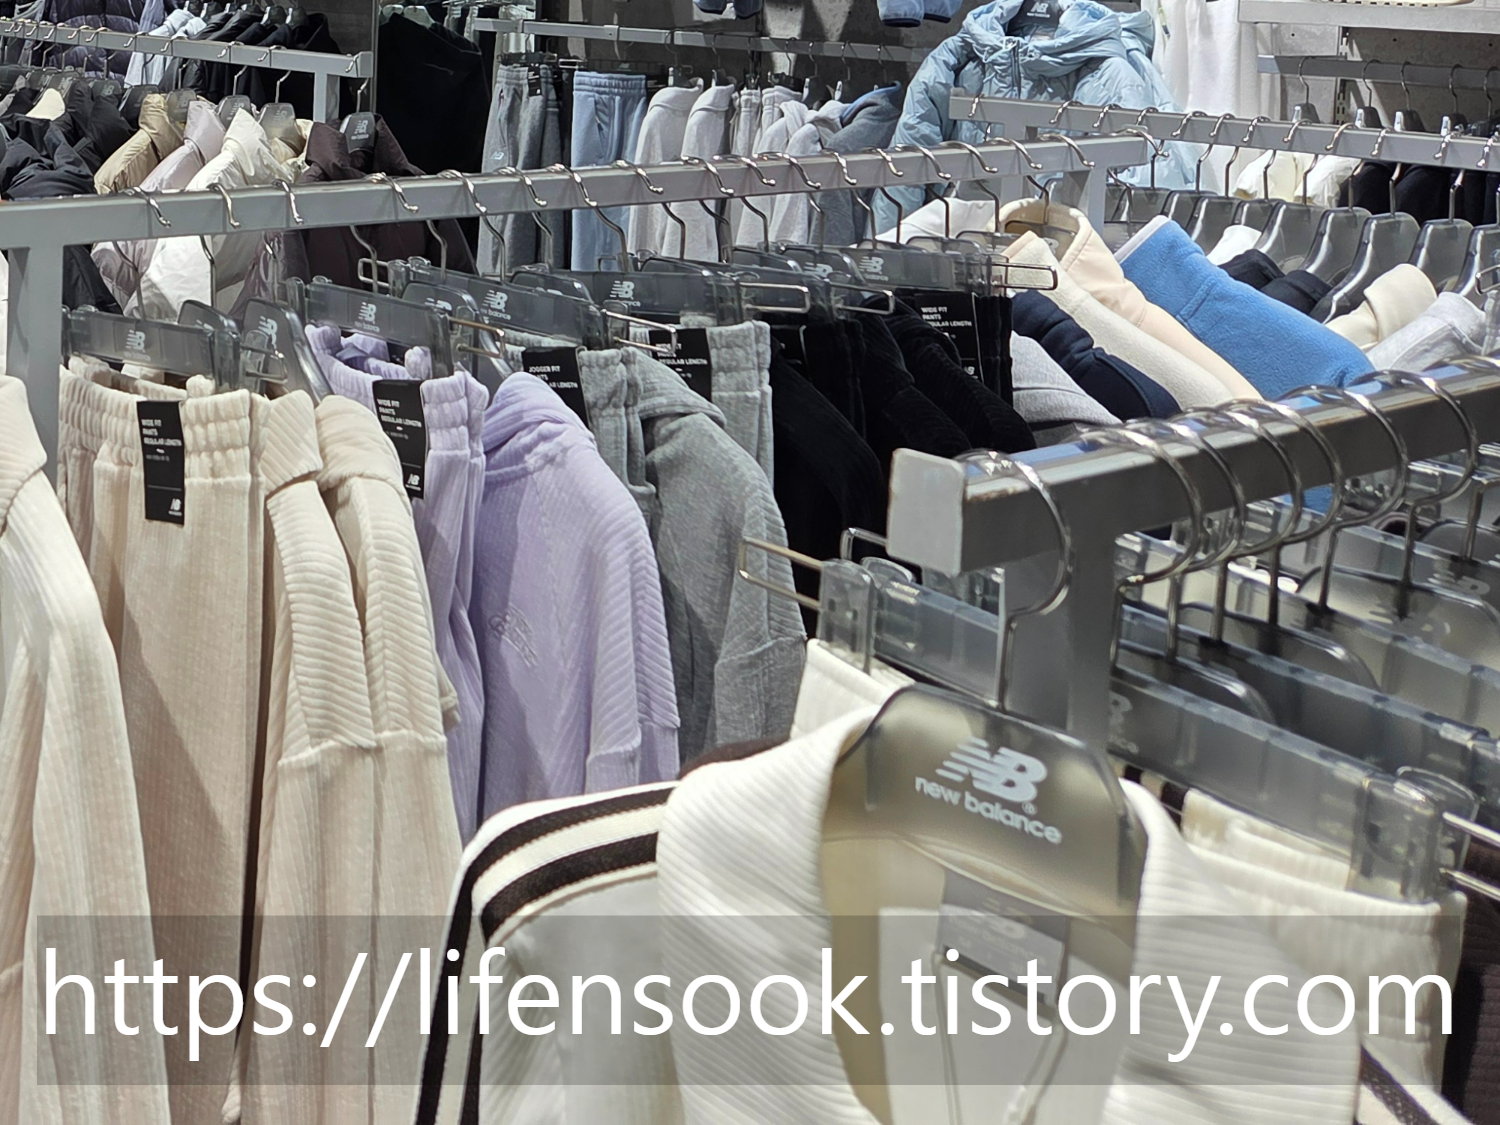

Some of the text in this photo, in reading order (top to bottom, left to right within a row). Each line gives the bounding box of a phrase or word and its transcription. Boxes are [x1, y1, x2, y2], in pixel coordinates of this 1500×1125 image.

[935, 736, 1048, 803] NB
[914, 776, 1063, 845] new balance
